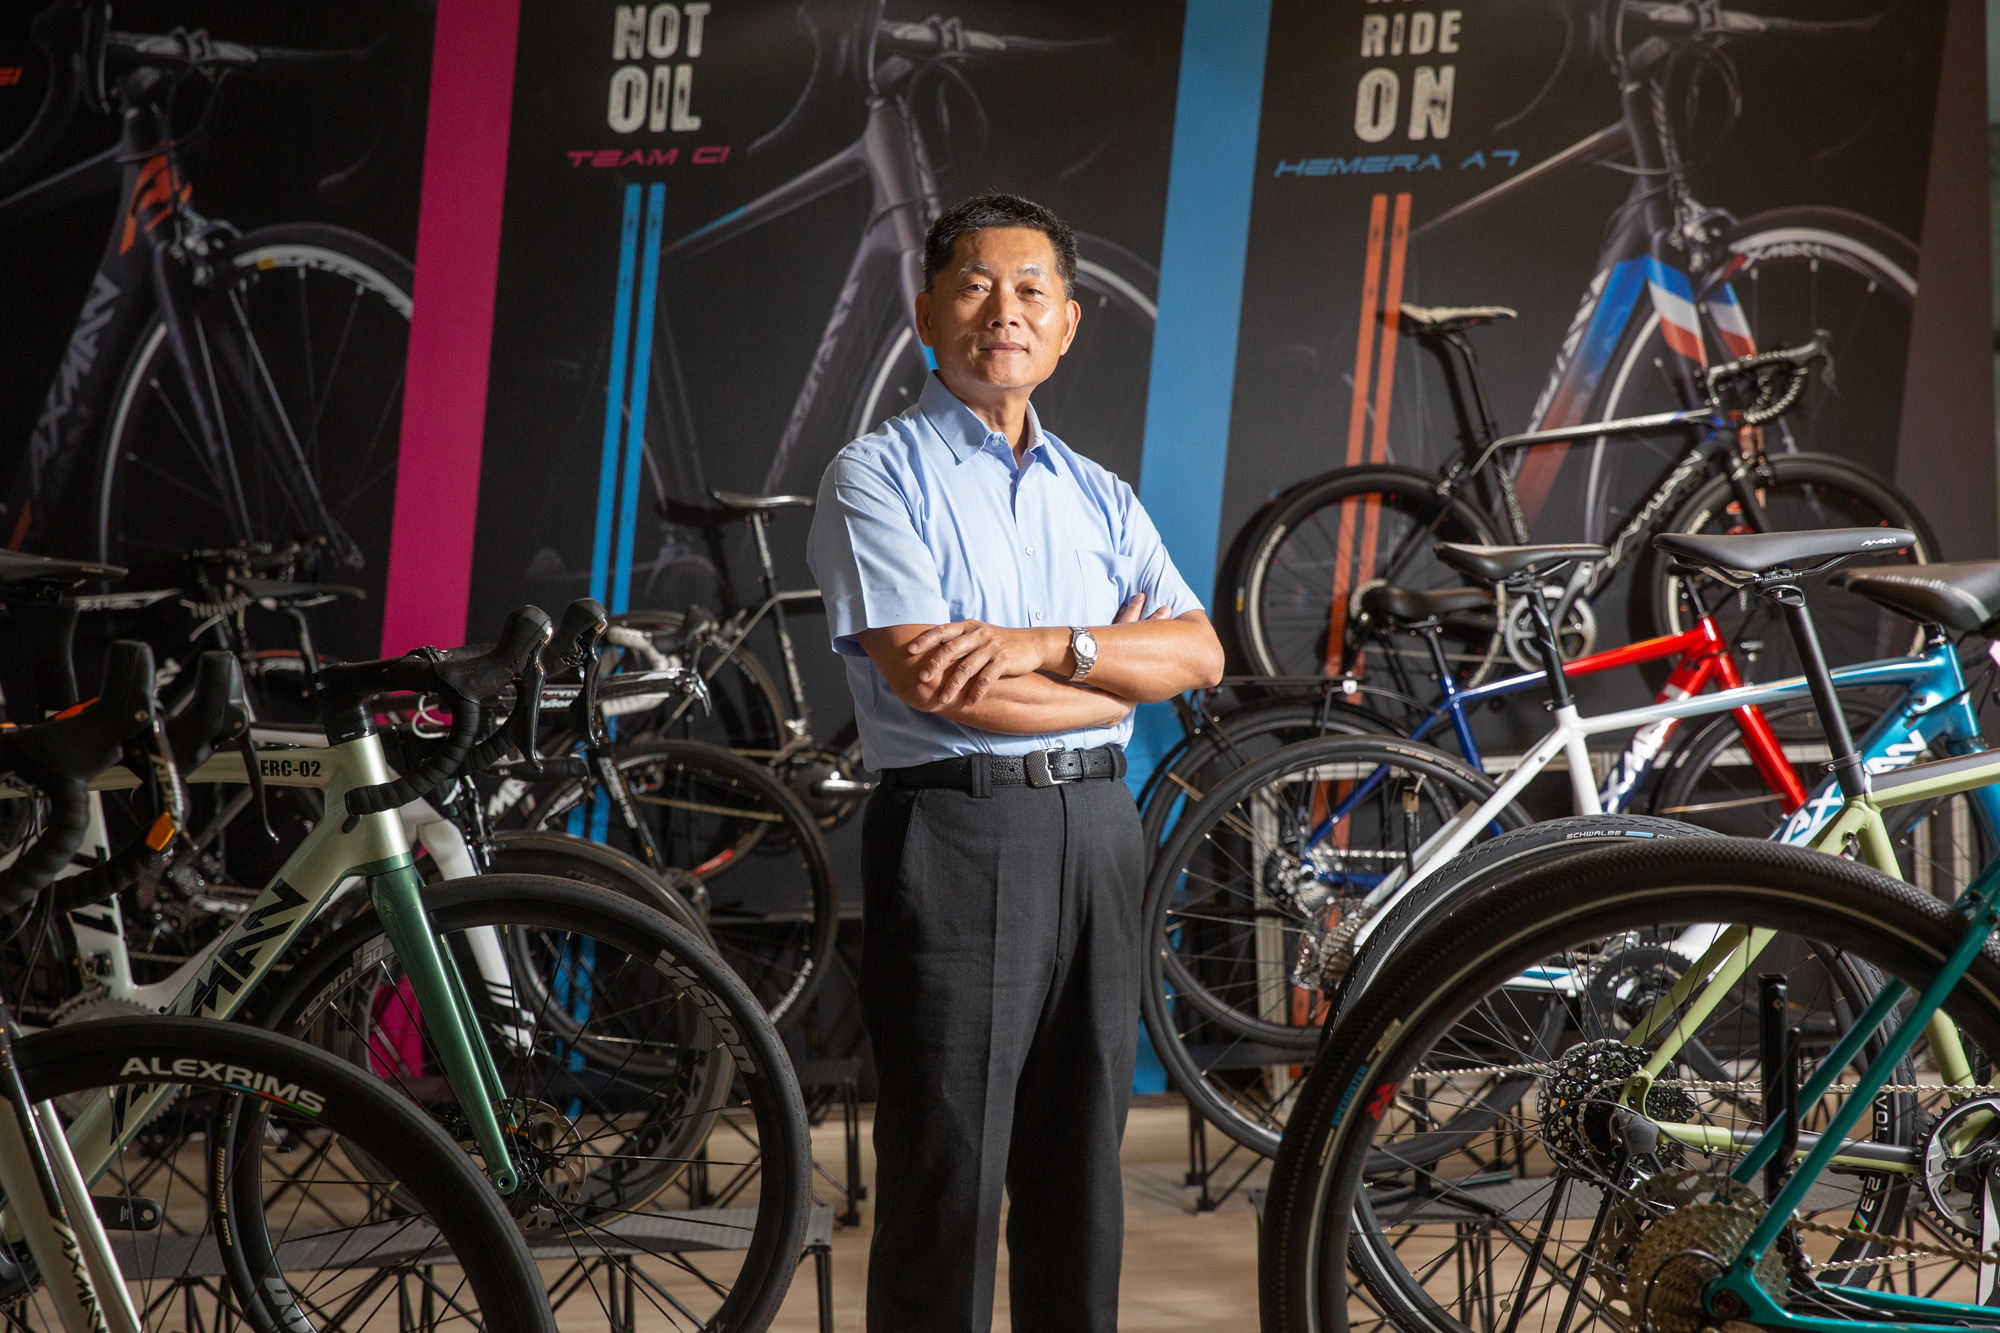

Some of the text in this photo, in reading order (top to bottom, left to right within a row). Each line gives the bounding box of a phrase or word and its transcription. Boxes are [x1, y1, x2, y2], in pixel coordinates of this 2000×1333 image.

[612, 2, 711, 60] NOT
[1360, 10, 1462, 57] RIDE
[607, 64, 702, 134] OIL
[1354, 64, 1455, 142] ON
[566, 147, 679, 169] TEAM
[1274, 149, 1520, 177] HEMERA A7
[260, 760, 322, 777] ERC-02
[1783, 729, 1927, 844] AXAN
[1566, 830, 1622, 840] SCHWALBE
[120, 1057, 326, 1113] ALEXRIMS
[1861, 1093, 1888, 1213] VOL 2.3
[221, 1218, 233, 1246] MAXXIS
